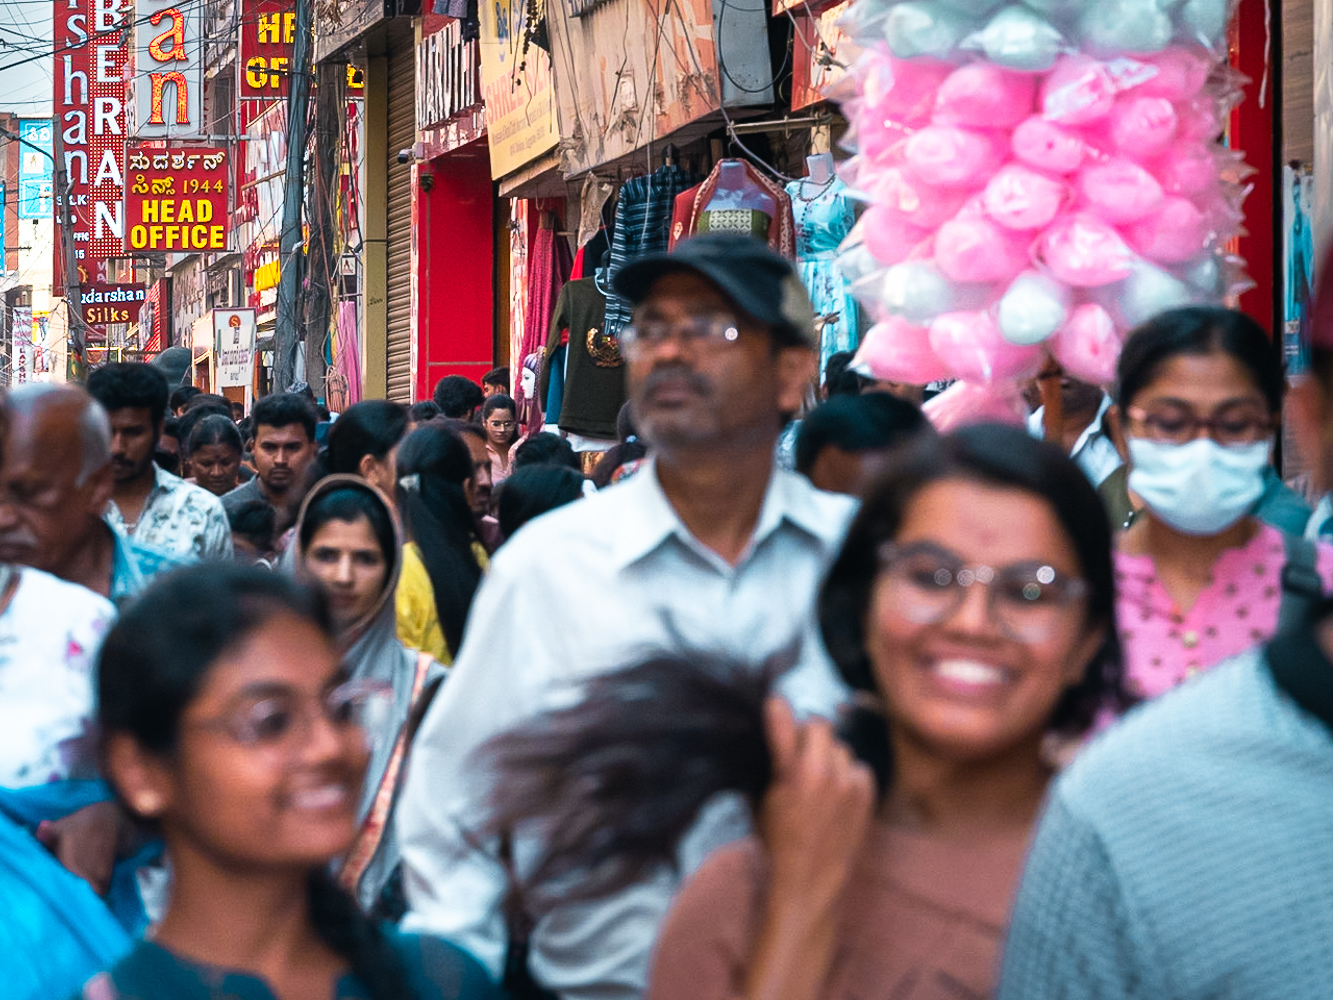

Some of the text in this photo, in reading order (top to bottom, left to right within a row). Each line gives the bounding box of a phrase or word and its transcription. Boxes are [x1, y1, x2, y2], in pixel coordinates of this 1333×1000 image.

[129, 151, 225, 172] ಸುದರ್ಶನ್
[183, 179, 224, 195] 1944
[142, 199, 213, 223] HEAD
[130, 224, 225, 249] OFFICE
[86, 307, 130, 324] Silks
